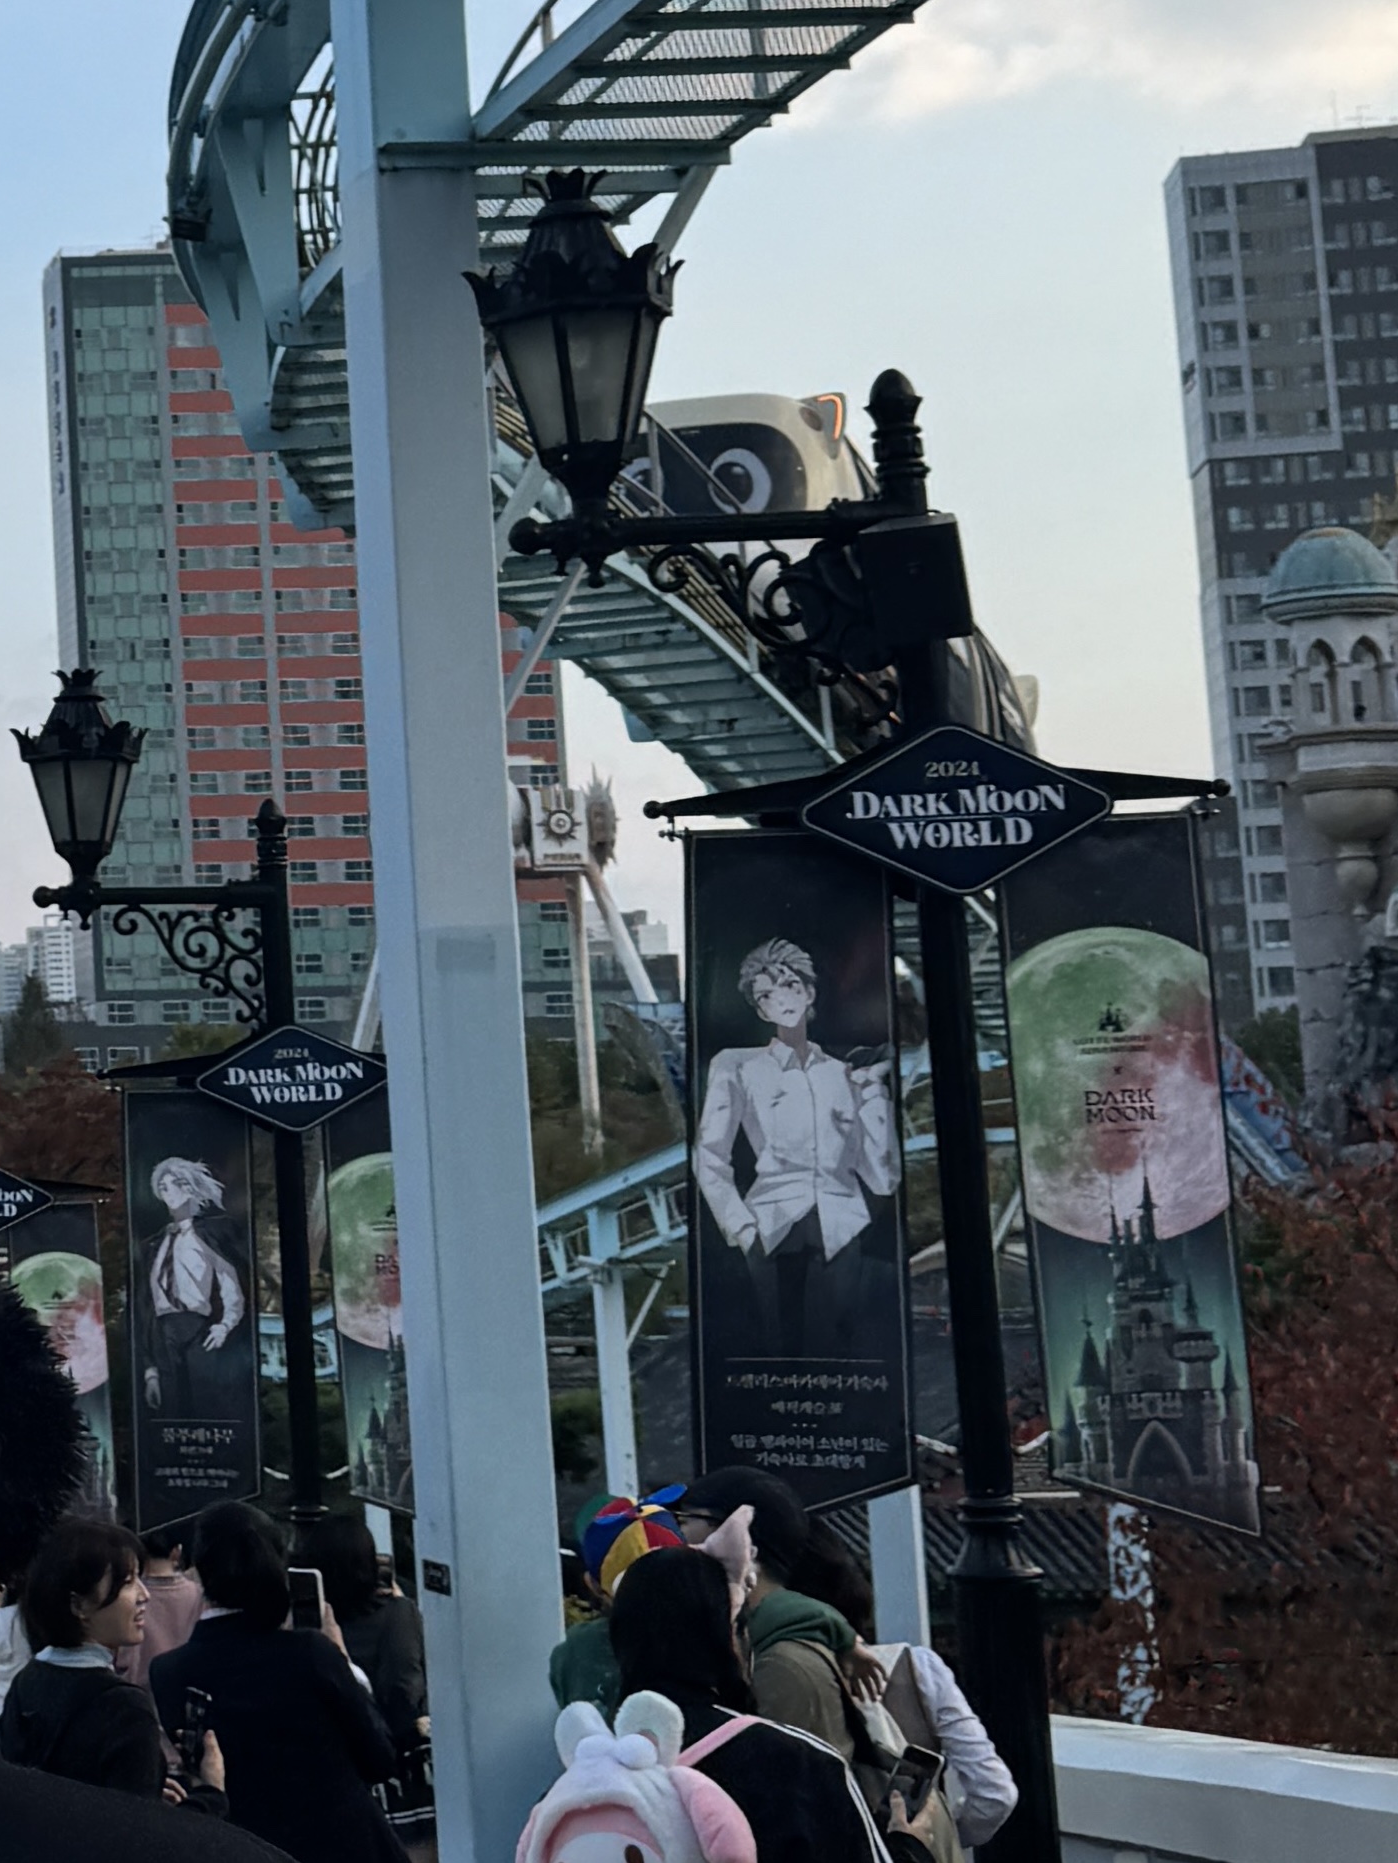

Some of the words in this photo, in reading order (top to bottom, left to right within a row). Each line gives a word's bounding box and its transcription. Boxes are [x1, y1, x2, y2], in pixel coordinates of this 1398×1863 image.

[925, 761, 981, 777] 2024
[846, 790, 954, 819] DARK
[957, 784, 1066, 816] MOON
[886, 817, 1033, 850] WORLD
[274, 1047, 309, 1059] 2024
[223, 1067, 292, 1086] DARK
[294, 1061, 364, 1083] MOON
[250, 1082, 343, 1104] WORLD
[1084, 1088, 1154, 1106] DARK
[1086, 1105, 1156, 1124] MOON
